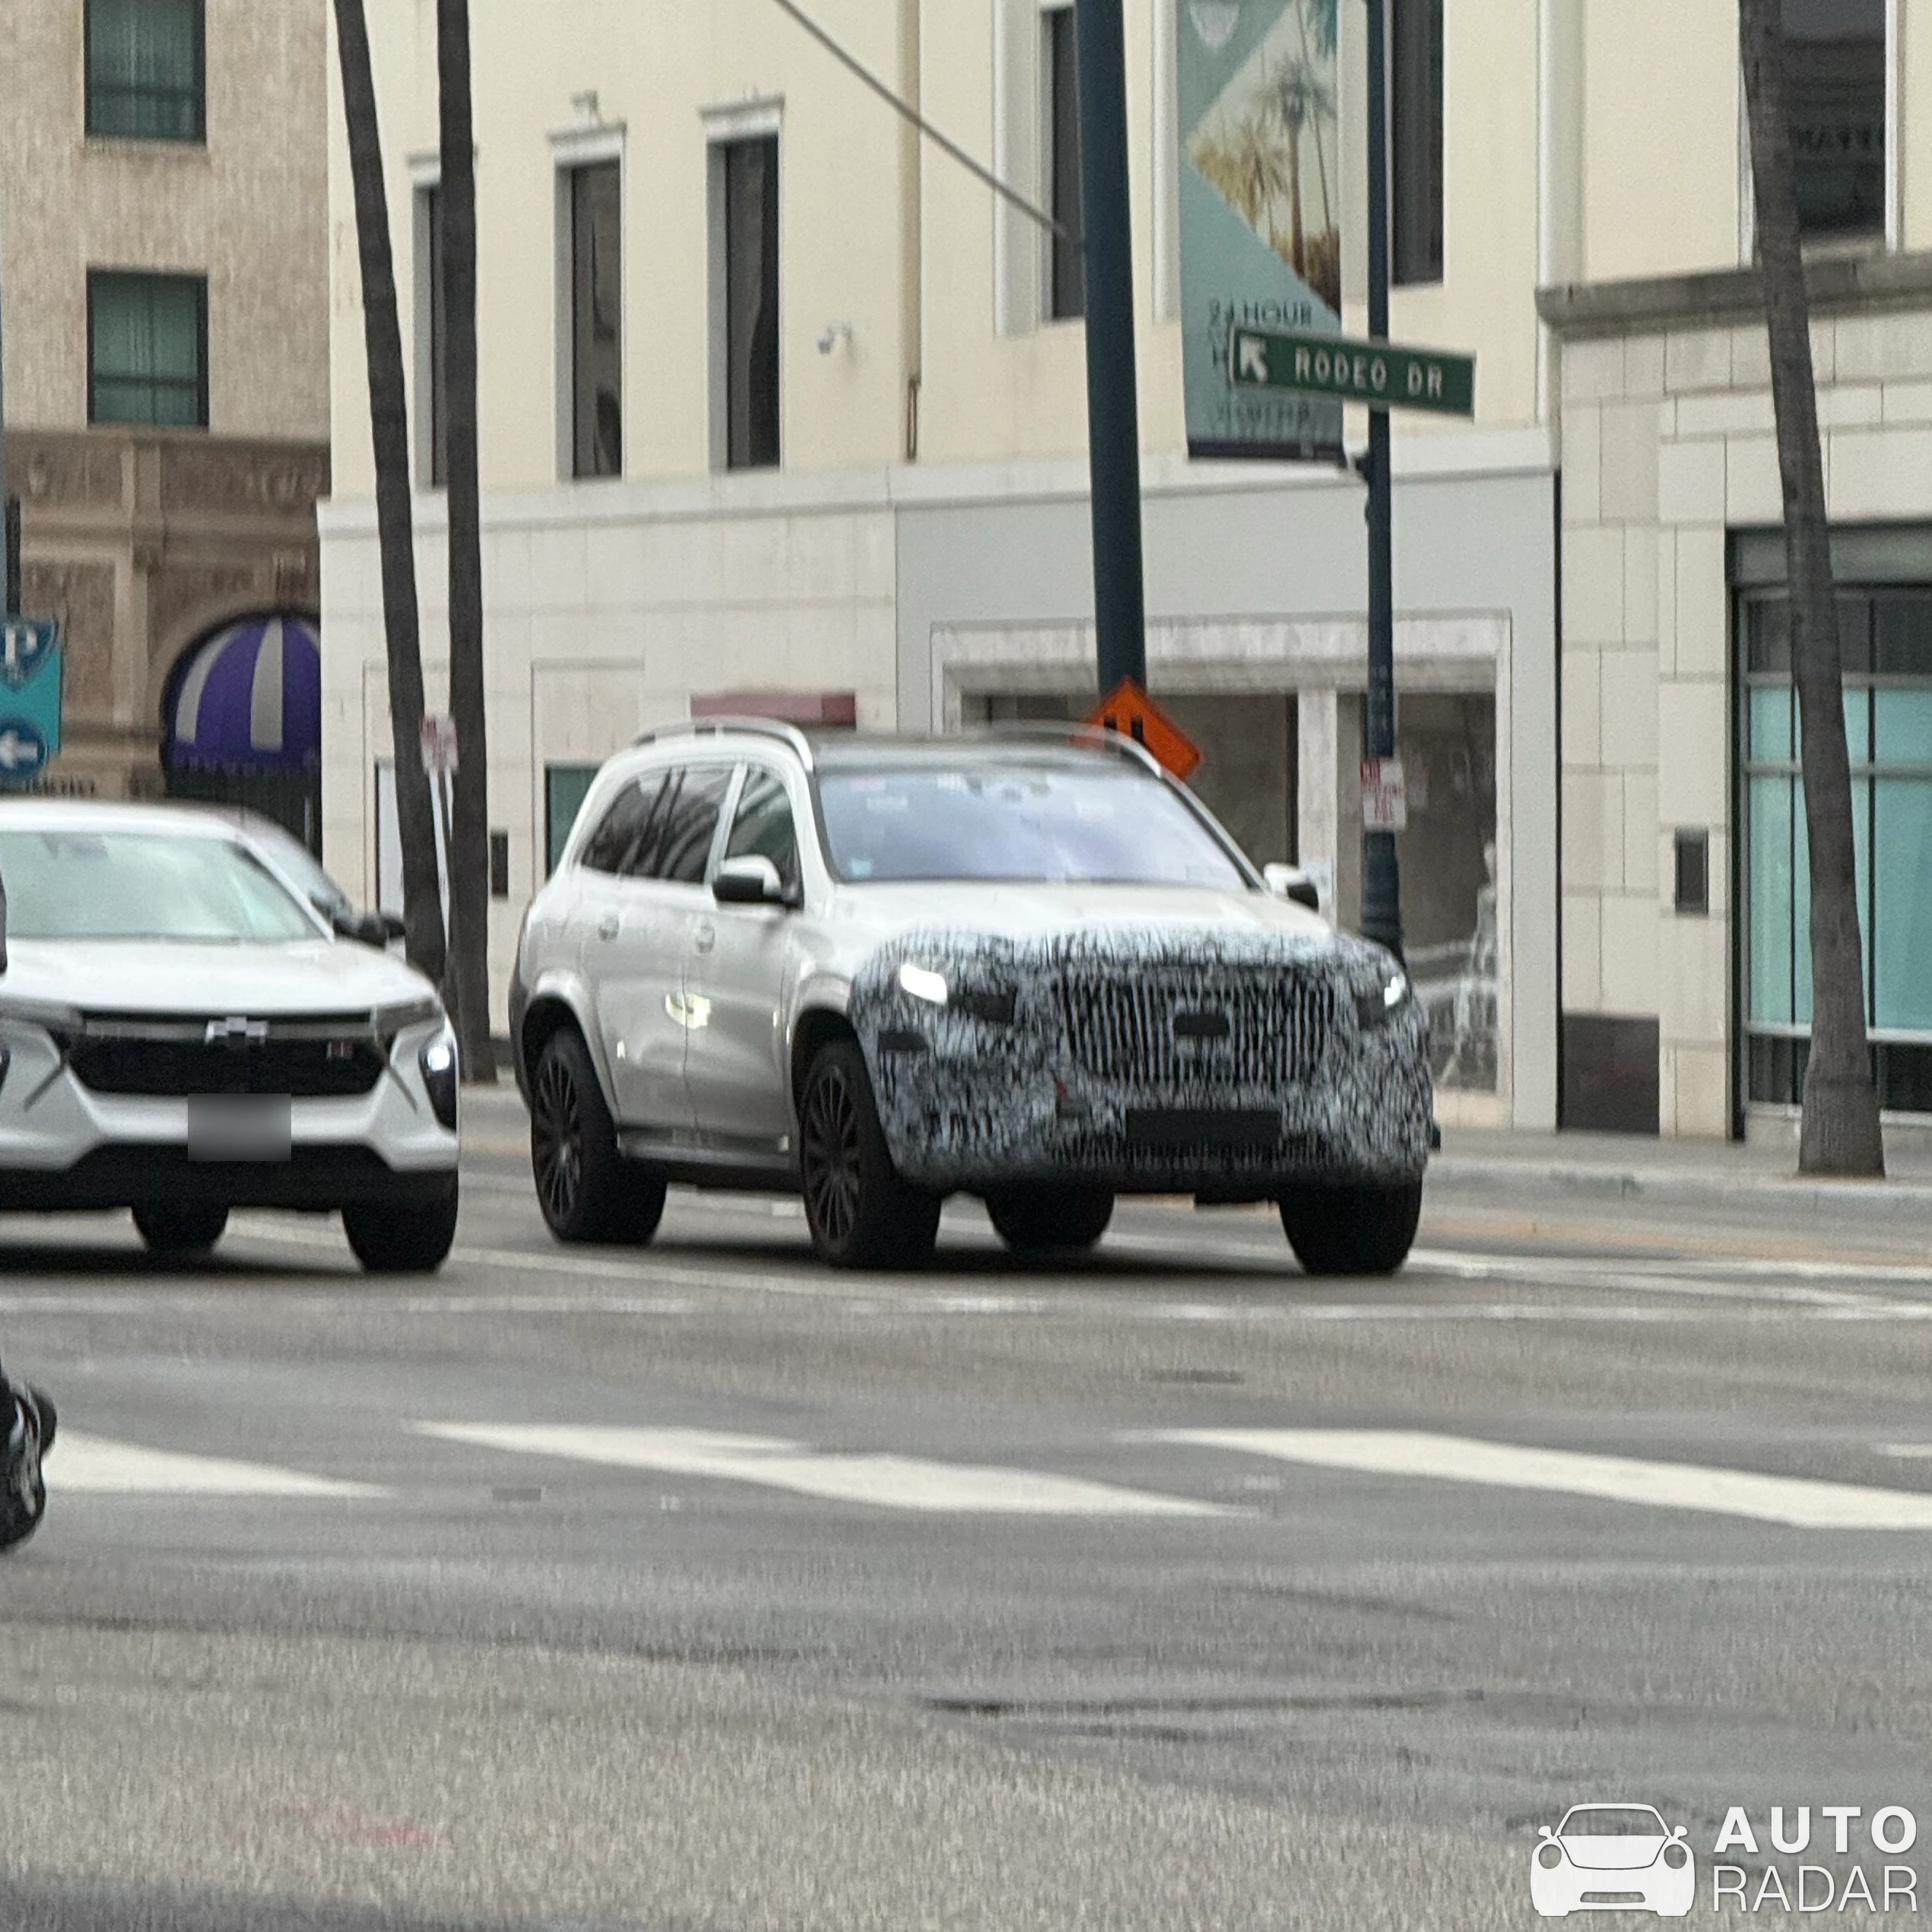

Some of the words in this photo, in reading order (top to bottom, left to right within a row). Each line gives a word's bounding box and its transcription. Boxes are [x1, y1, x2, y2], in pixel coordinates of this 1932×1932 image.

[1243, 300, 1312, 327] HOUR
[1295, 347, 1387, 392] RODEO
[1408, 361, 1442, 399] DR
